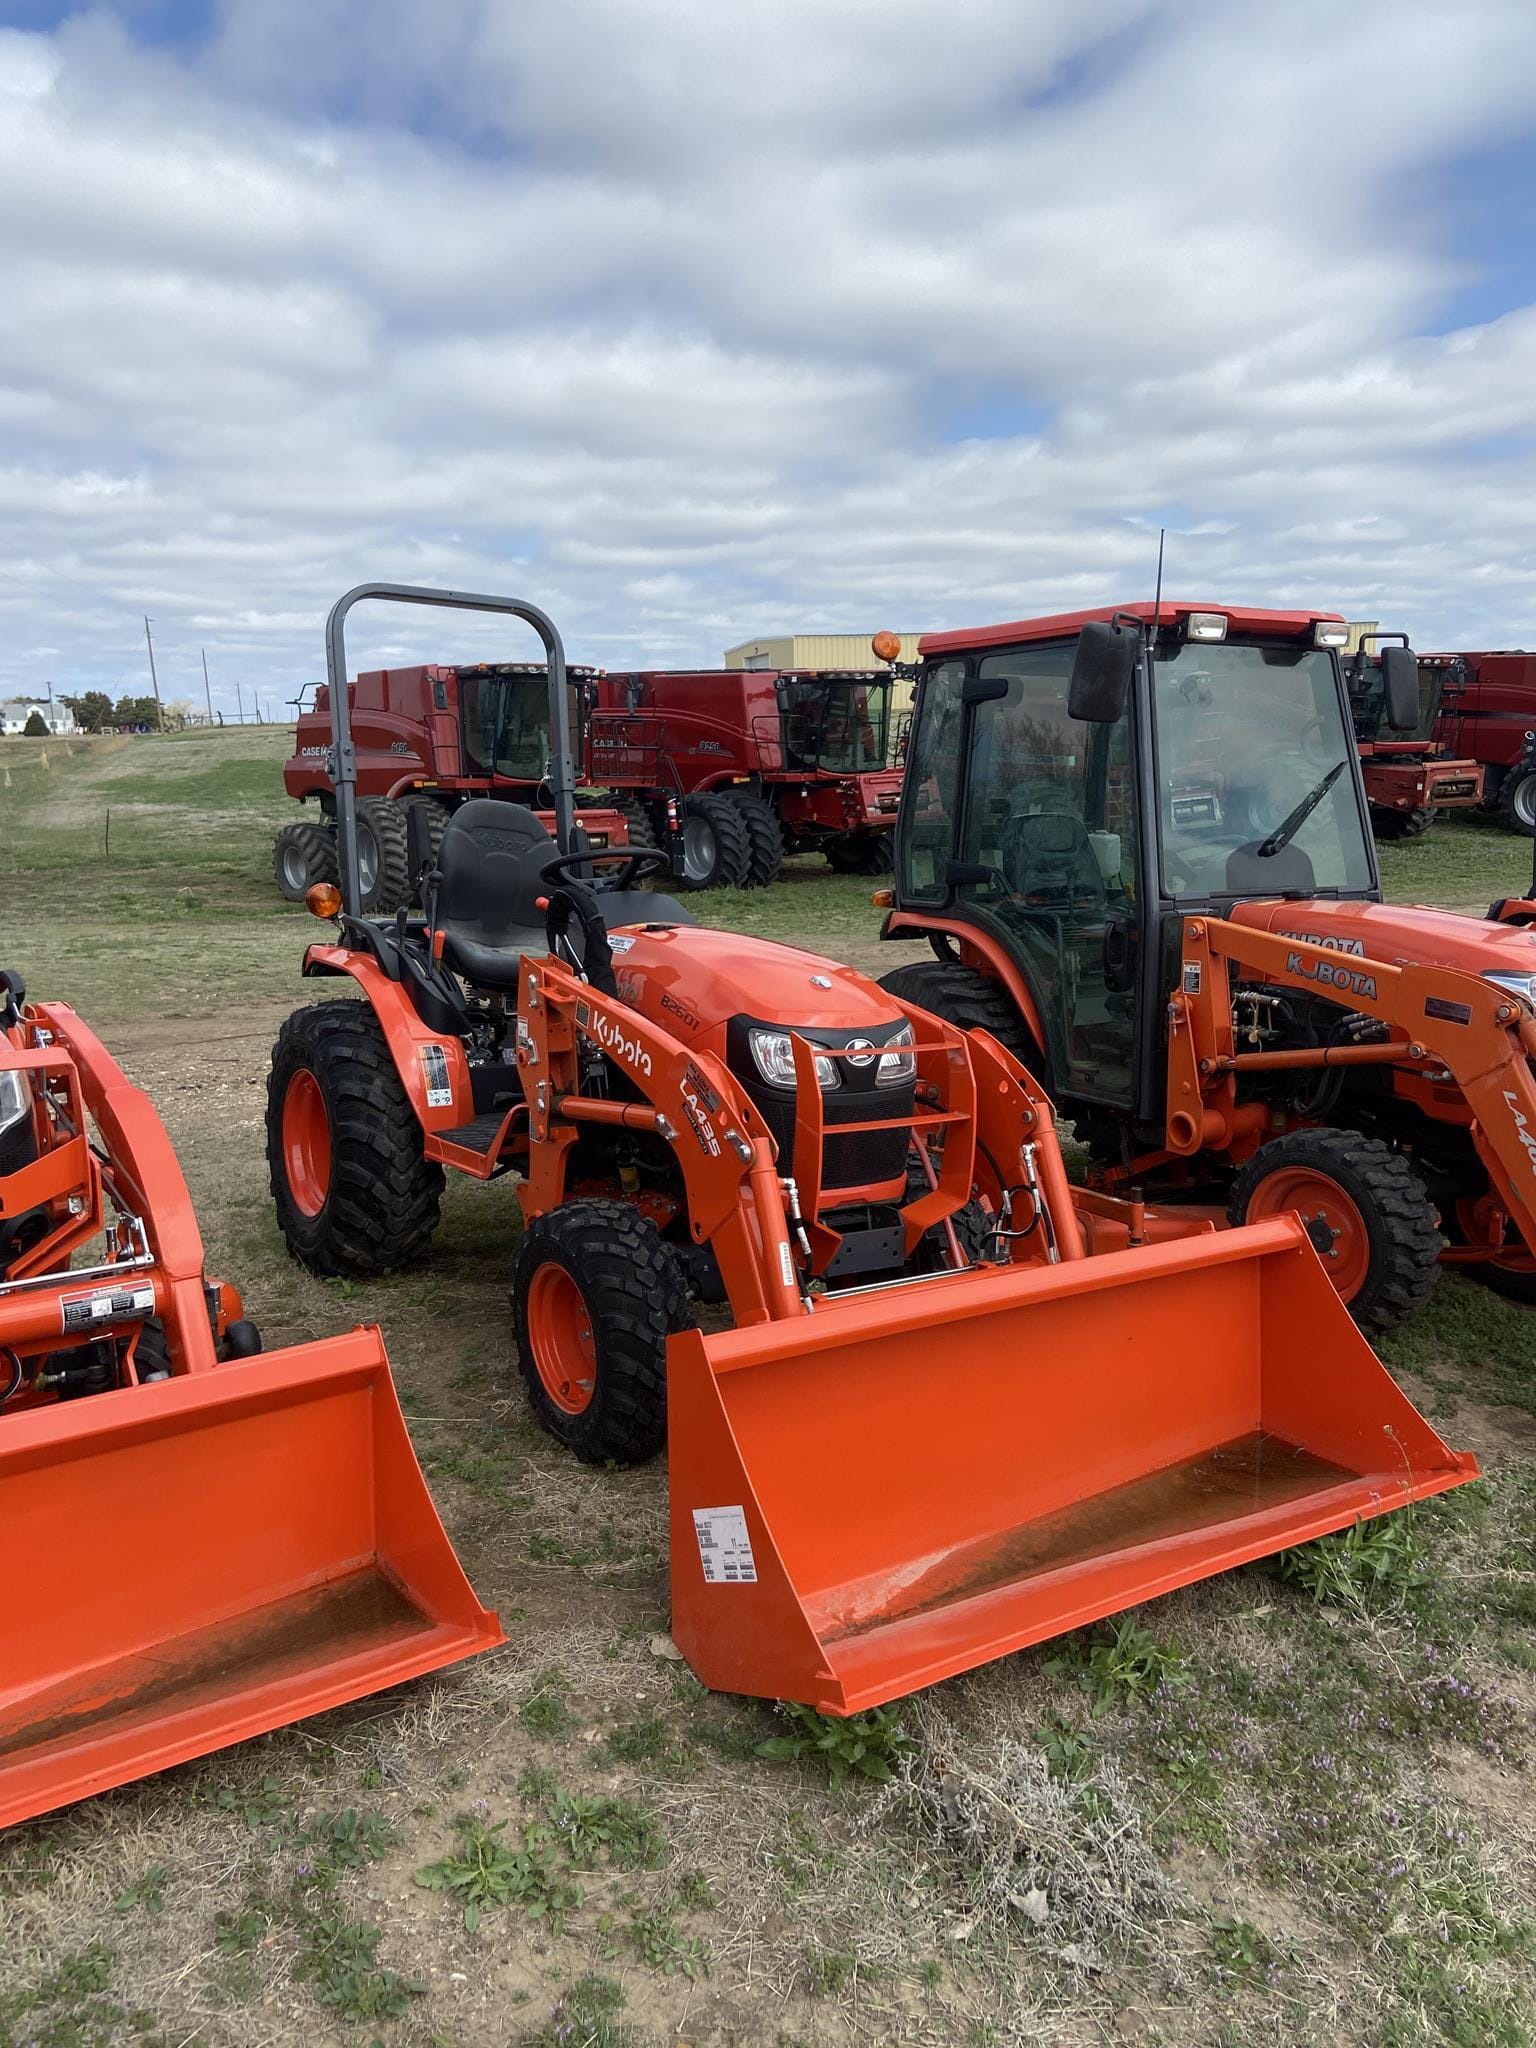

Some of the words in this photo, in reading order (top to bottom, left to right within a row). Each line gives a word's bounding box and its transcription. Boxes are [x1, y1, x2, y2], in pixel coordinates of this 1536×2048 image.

[301, 746, 320, 757] CASE
[1276, 930, 1365, 958] BOTA
[1286, 952, 1378, 1001] KUBOTA
[593, 1010, 652, 1077] Kubota
[680, 1078, 721, 1157] LA435
